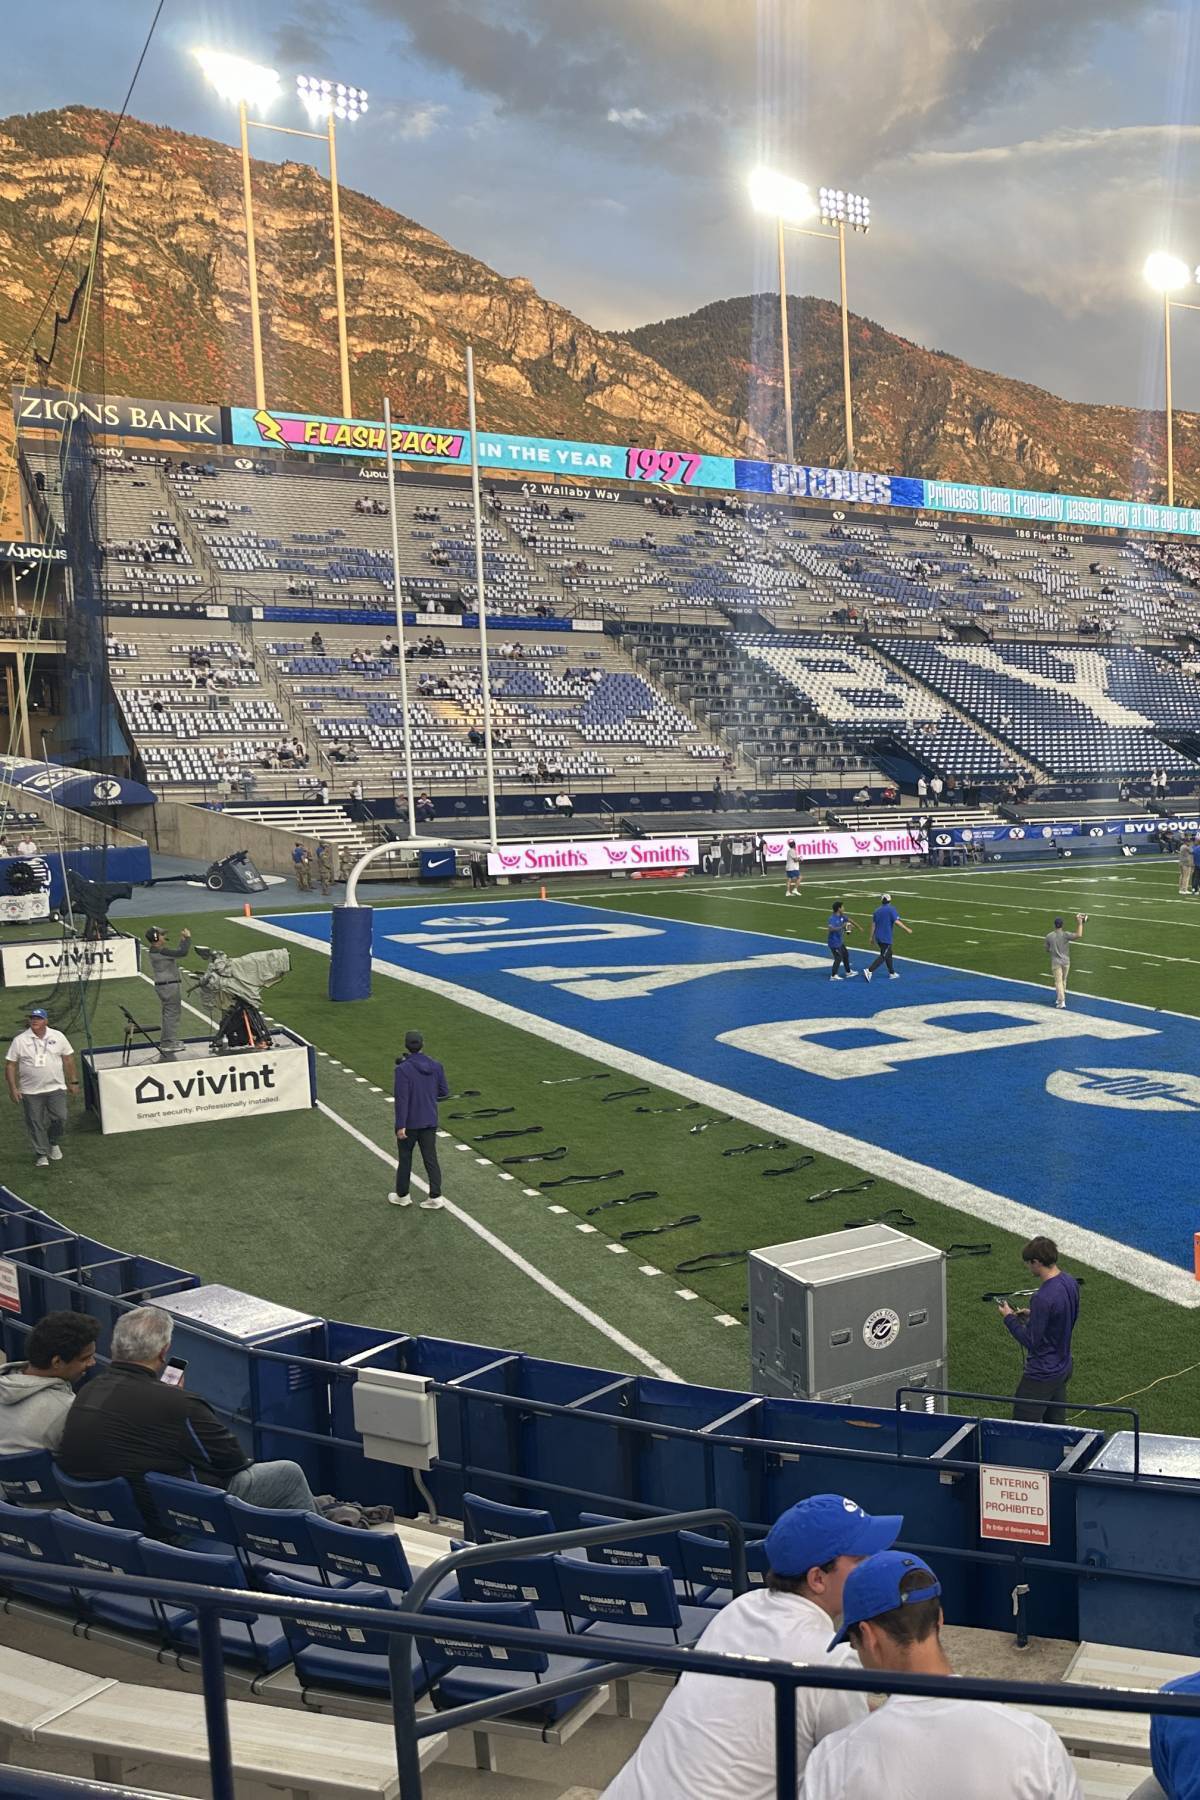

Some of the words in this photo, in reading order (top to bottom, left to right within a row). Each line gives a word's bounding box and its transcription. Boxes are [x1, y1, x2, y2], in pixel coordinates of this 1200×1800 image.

[20, 397, 119, 426] ZIONS
[129, 407, 217, 436] BANK
[303, 421, 454, 457] FLASHBACK
[480, 442, 501, 457] IN
[508, 445, 550, 462] THE
[556, 450, 612, 469] YEAR
[625, 447, 701, 485] 1997
[540, 484, 590, 501] Wallaby
[595, 489, 620, 502] Way
[771, 463, 807, 495] GO
[808, 467, 891, 504] COUGS
[928, 482, 979, 511] Princess
[981, 488, 1011, 514] Diana
[1013, 494, 1063, 521] tragically
[1067, 499, 1102, 522] passed
[1104, 504, 1130, 529] away
[1132, 506, 1142, 526] at
[1143, 507, 1159, 529] the
[1161, 512, 1178, 533] age
[1180, 511, 1190, 531] of
[1015, 529, 1026, 539] 186
[1058, 533, 1083, 544] Street
[7, 543, 67, 560] smarty
[1124, 820, 1156, 833] BYU
[631, 844, 690, 865] Smith's
[795, 840, 838, 855] mith's
[525, 849, 588, 869] Smith's
[49, 947, 114, 967] vivint
[173, 1064, 275, 1099] vivint
[137, 1111, 161, 1120] Smart
[195, 1099, 246, 1112] Professionally
[989, 1476, 1039, 1490] ENTERING
[1000, 1490, 1028, 1502] FIELD
[985, 1501, 1044, 1516] PROHIBITED
